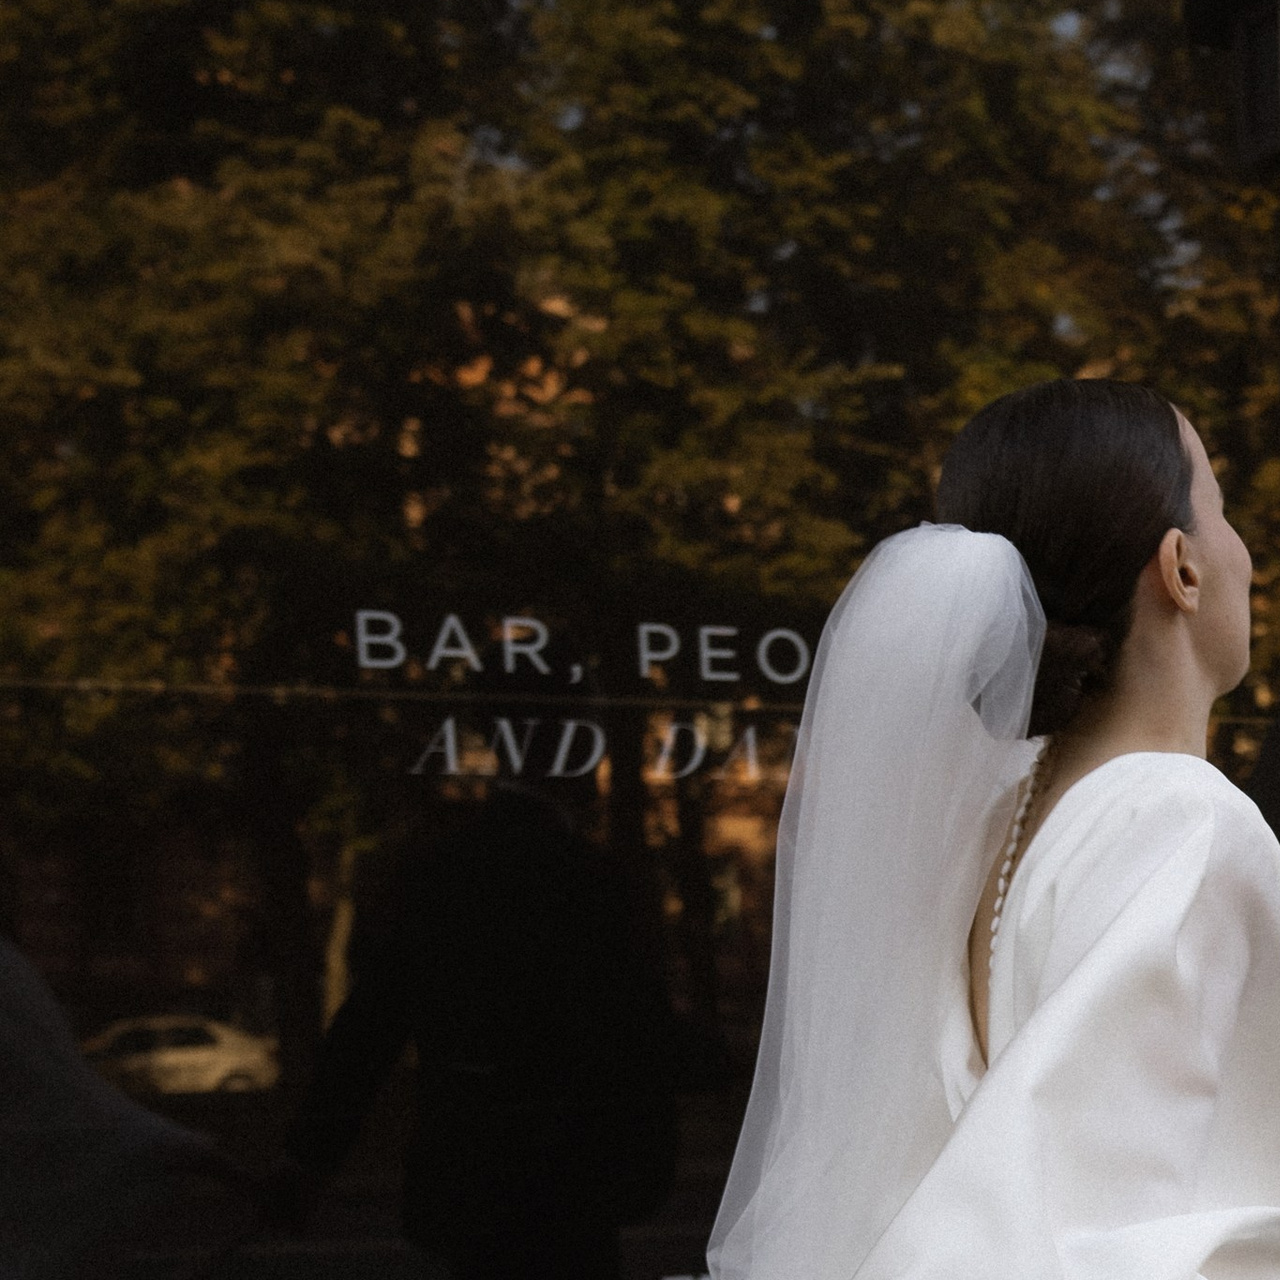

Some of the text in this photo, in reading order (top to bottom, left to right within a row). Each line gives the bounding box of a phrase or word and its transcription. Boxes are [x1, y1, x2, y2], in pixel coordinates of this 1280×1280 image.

[355, 608, 585, 685] BAR,
[408, 716, 798, 781] AND DA
